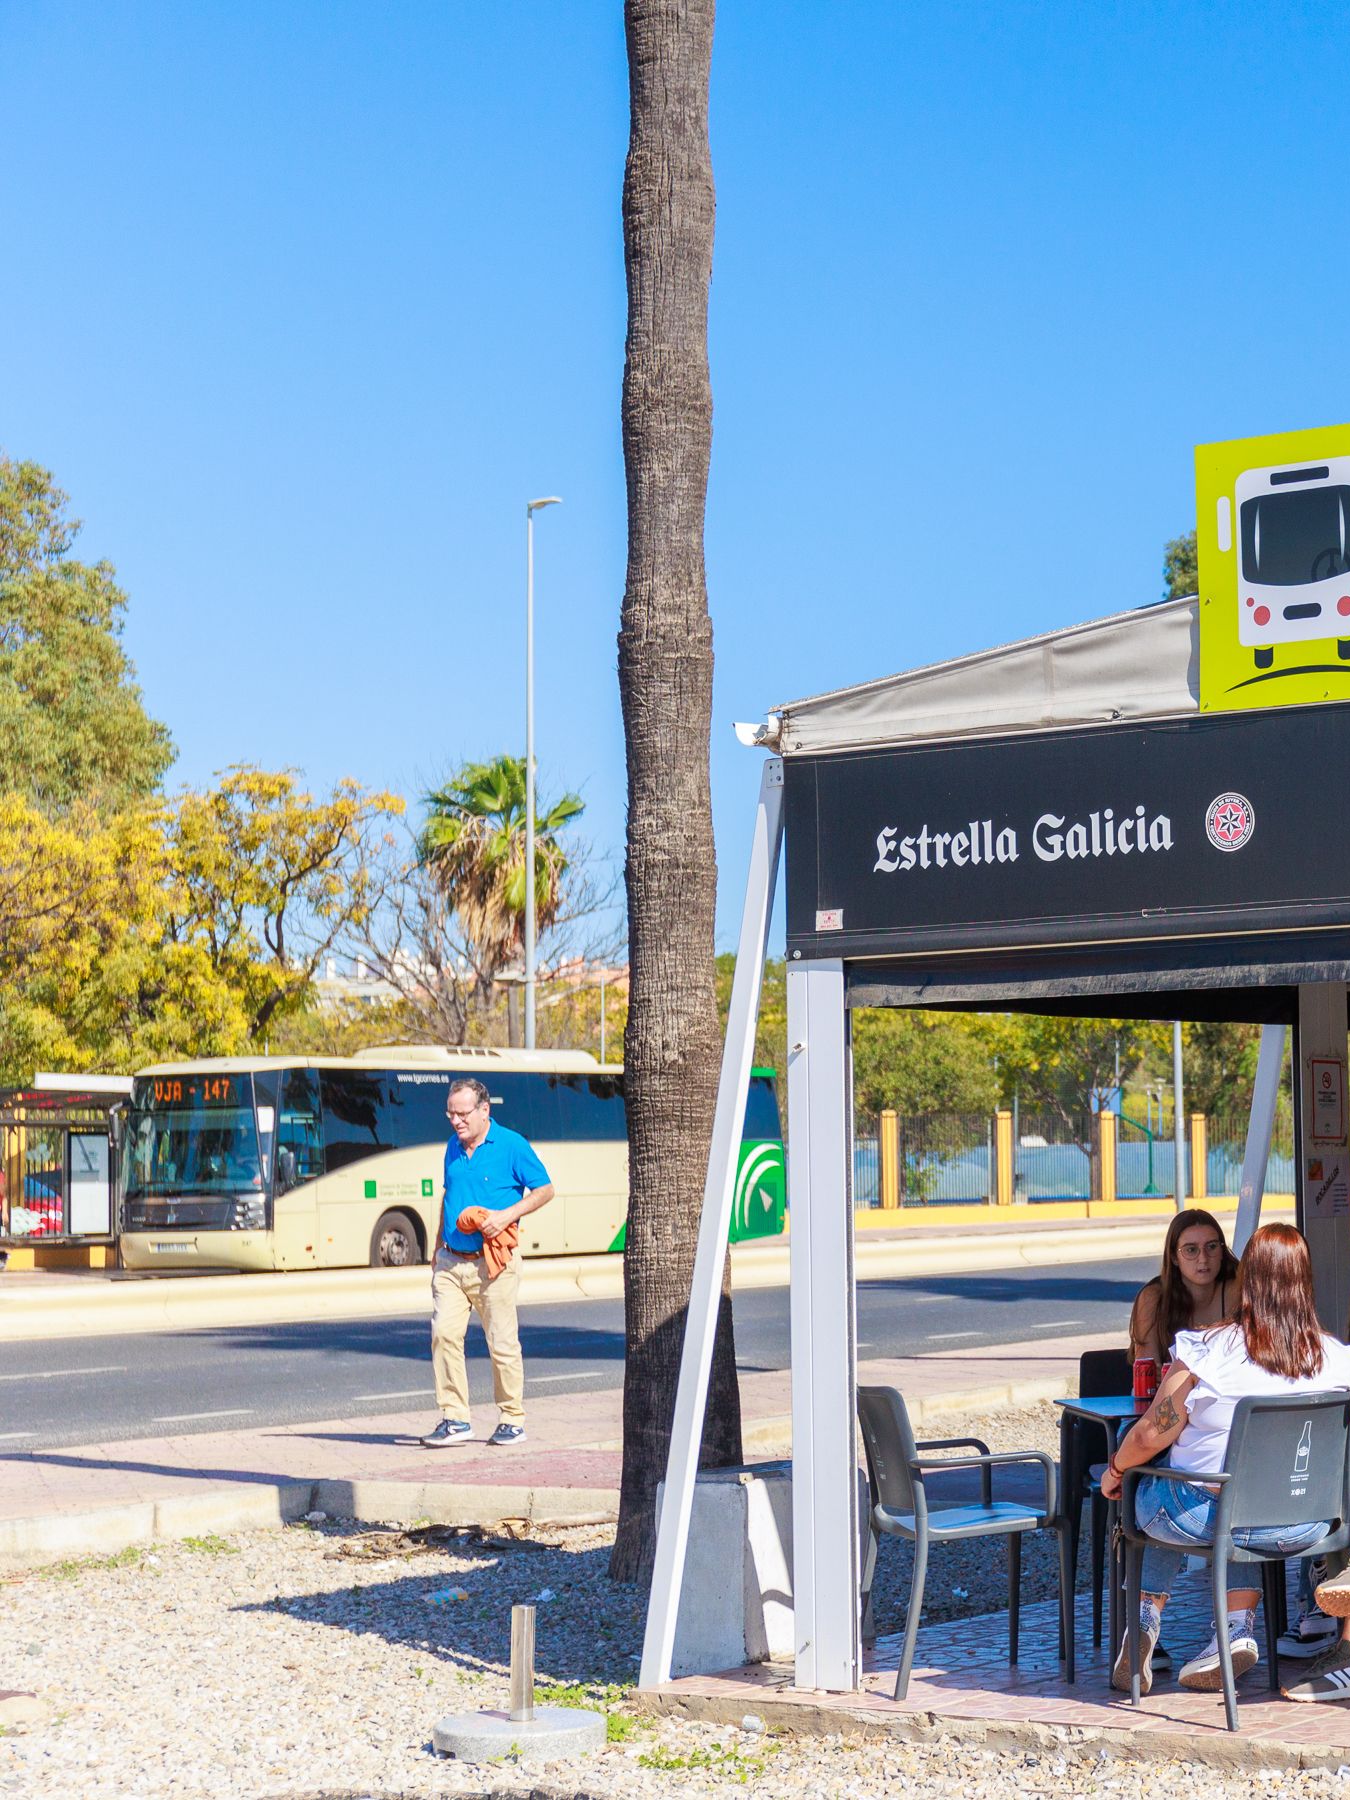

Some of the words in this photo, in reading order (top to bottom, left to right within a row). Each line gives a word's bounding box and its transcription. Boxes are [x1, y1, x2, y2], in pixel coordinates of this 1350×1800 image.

[873, 819, 1020, 873] Estrella
[1031, 805, 1175, 863] Galicia
[154, 1080, 182, 1102] VJA
[203, 1079, 230, 1101] 147
